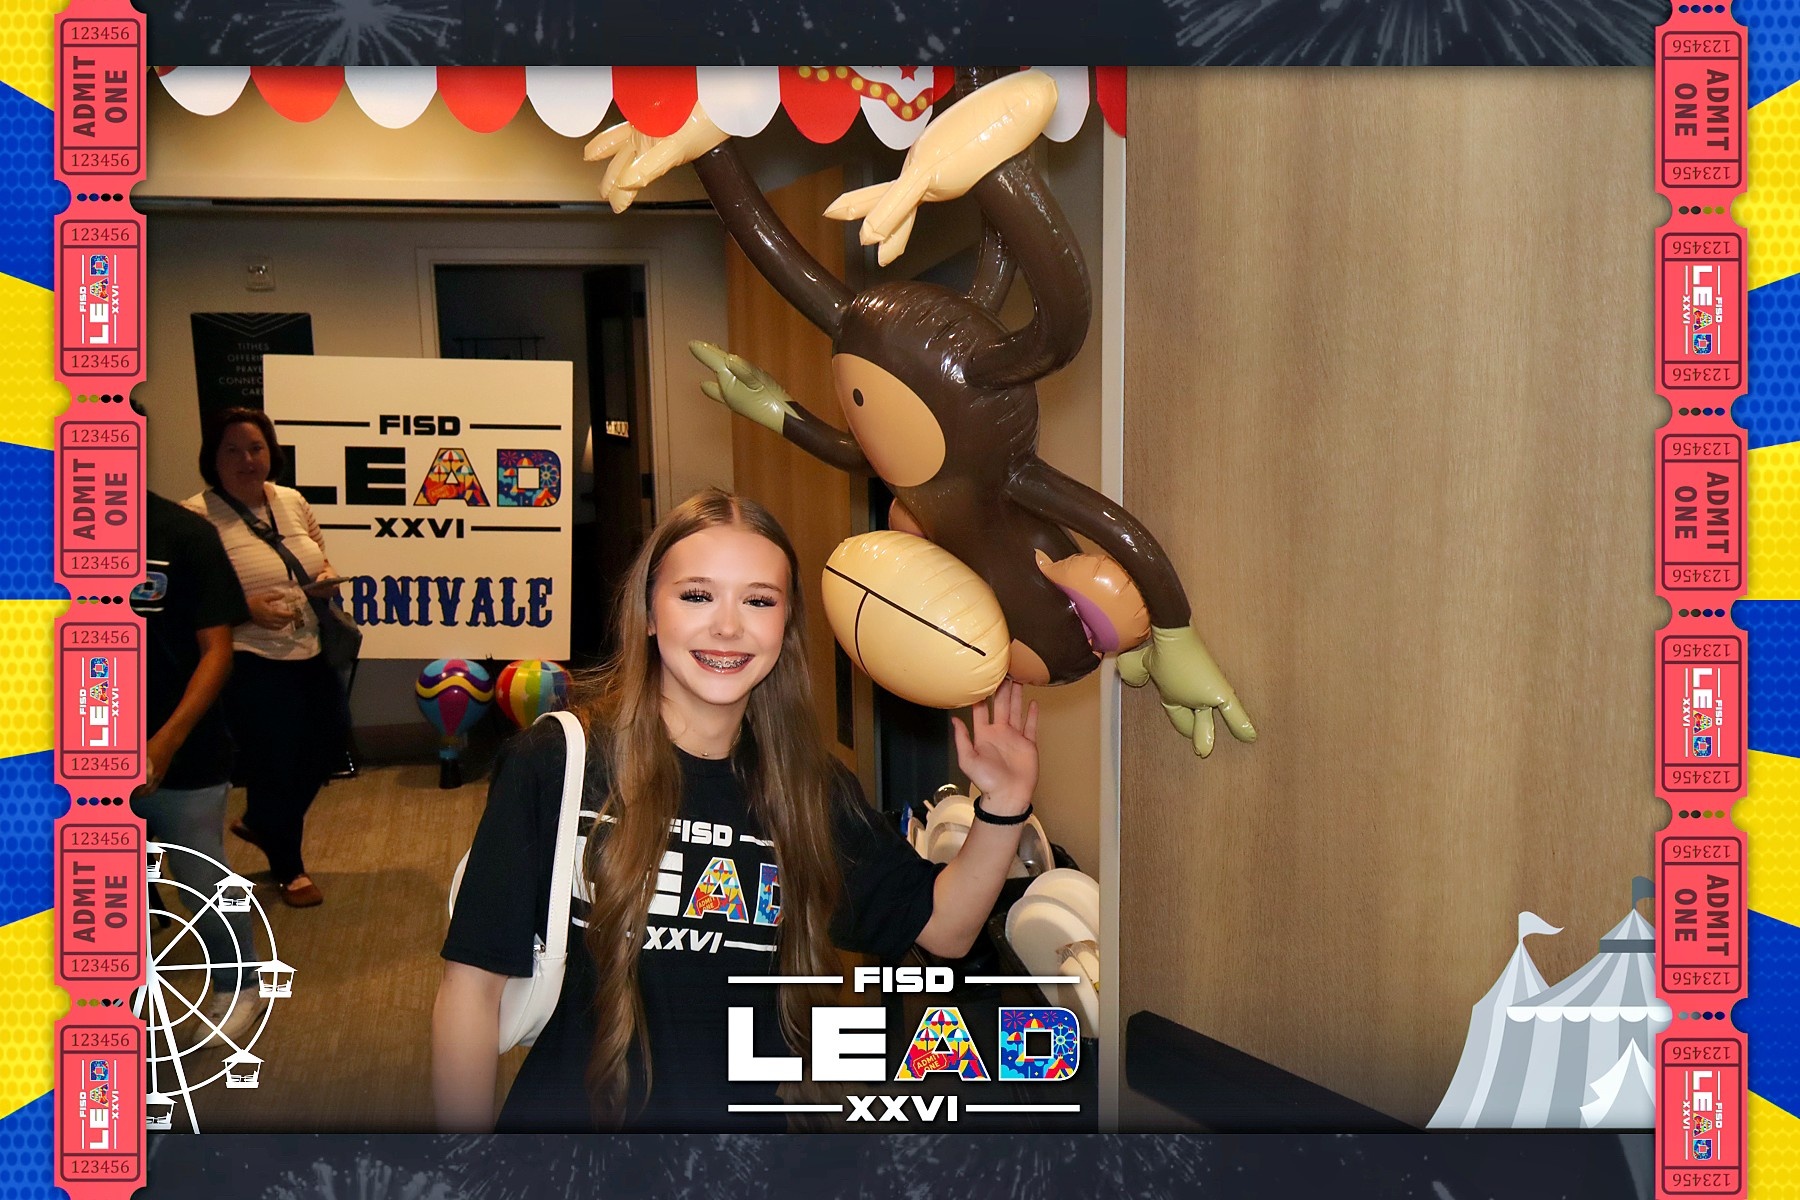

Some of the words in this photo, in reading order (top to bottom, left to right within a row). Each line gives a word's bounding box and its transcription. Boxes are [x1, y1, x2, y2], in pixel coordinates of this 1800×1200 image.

[238, 343, 270, 351] TITHES
[227, 354, 263, 362] OFFERI
[219, 376, 263, 384] CONNEC
[241, 387, 263, 395] CAR
[379, 414, 461, 436] FISD
[279, 445, 562, 507] LEAD
[374, 517, 465, 538] XXVI
[336, 575, 553, 627] RNIVALE
[642, 926, 723, 954] XXVI
